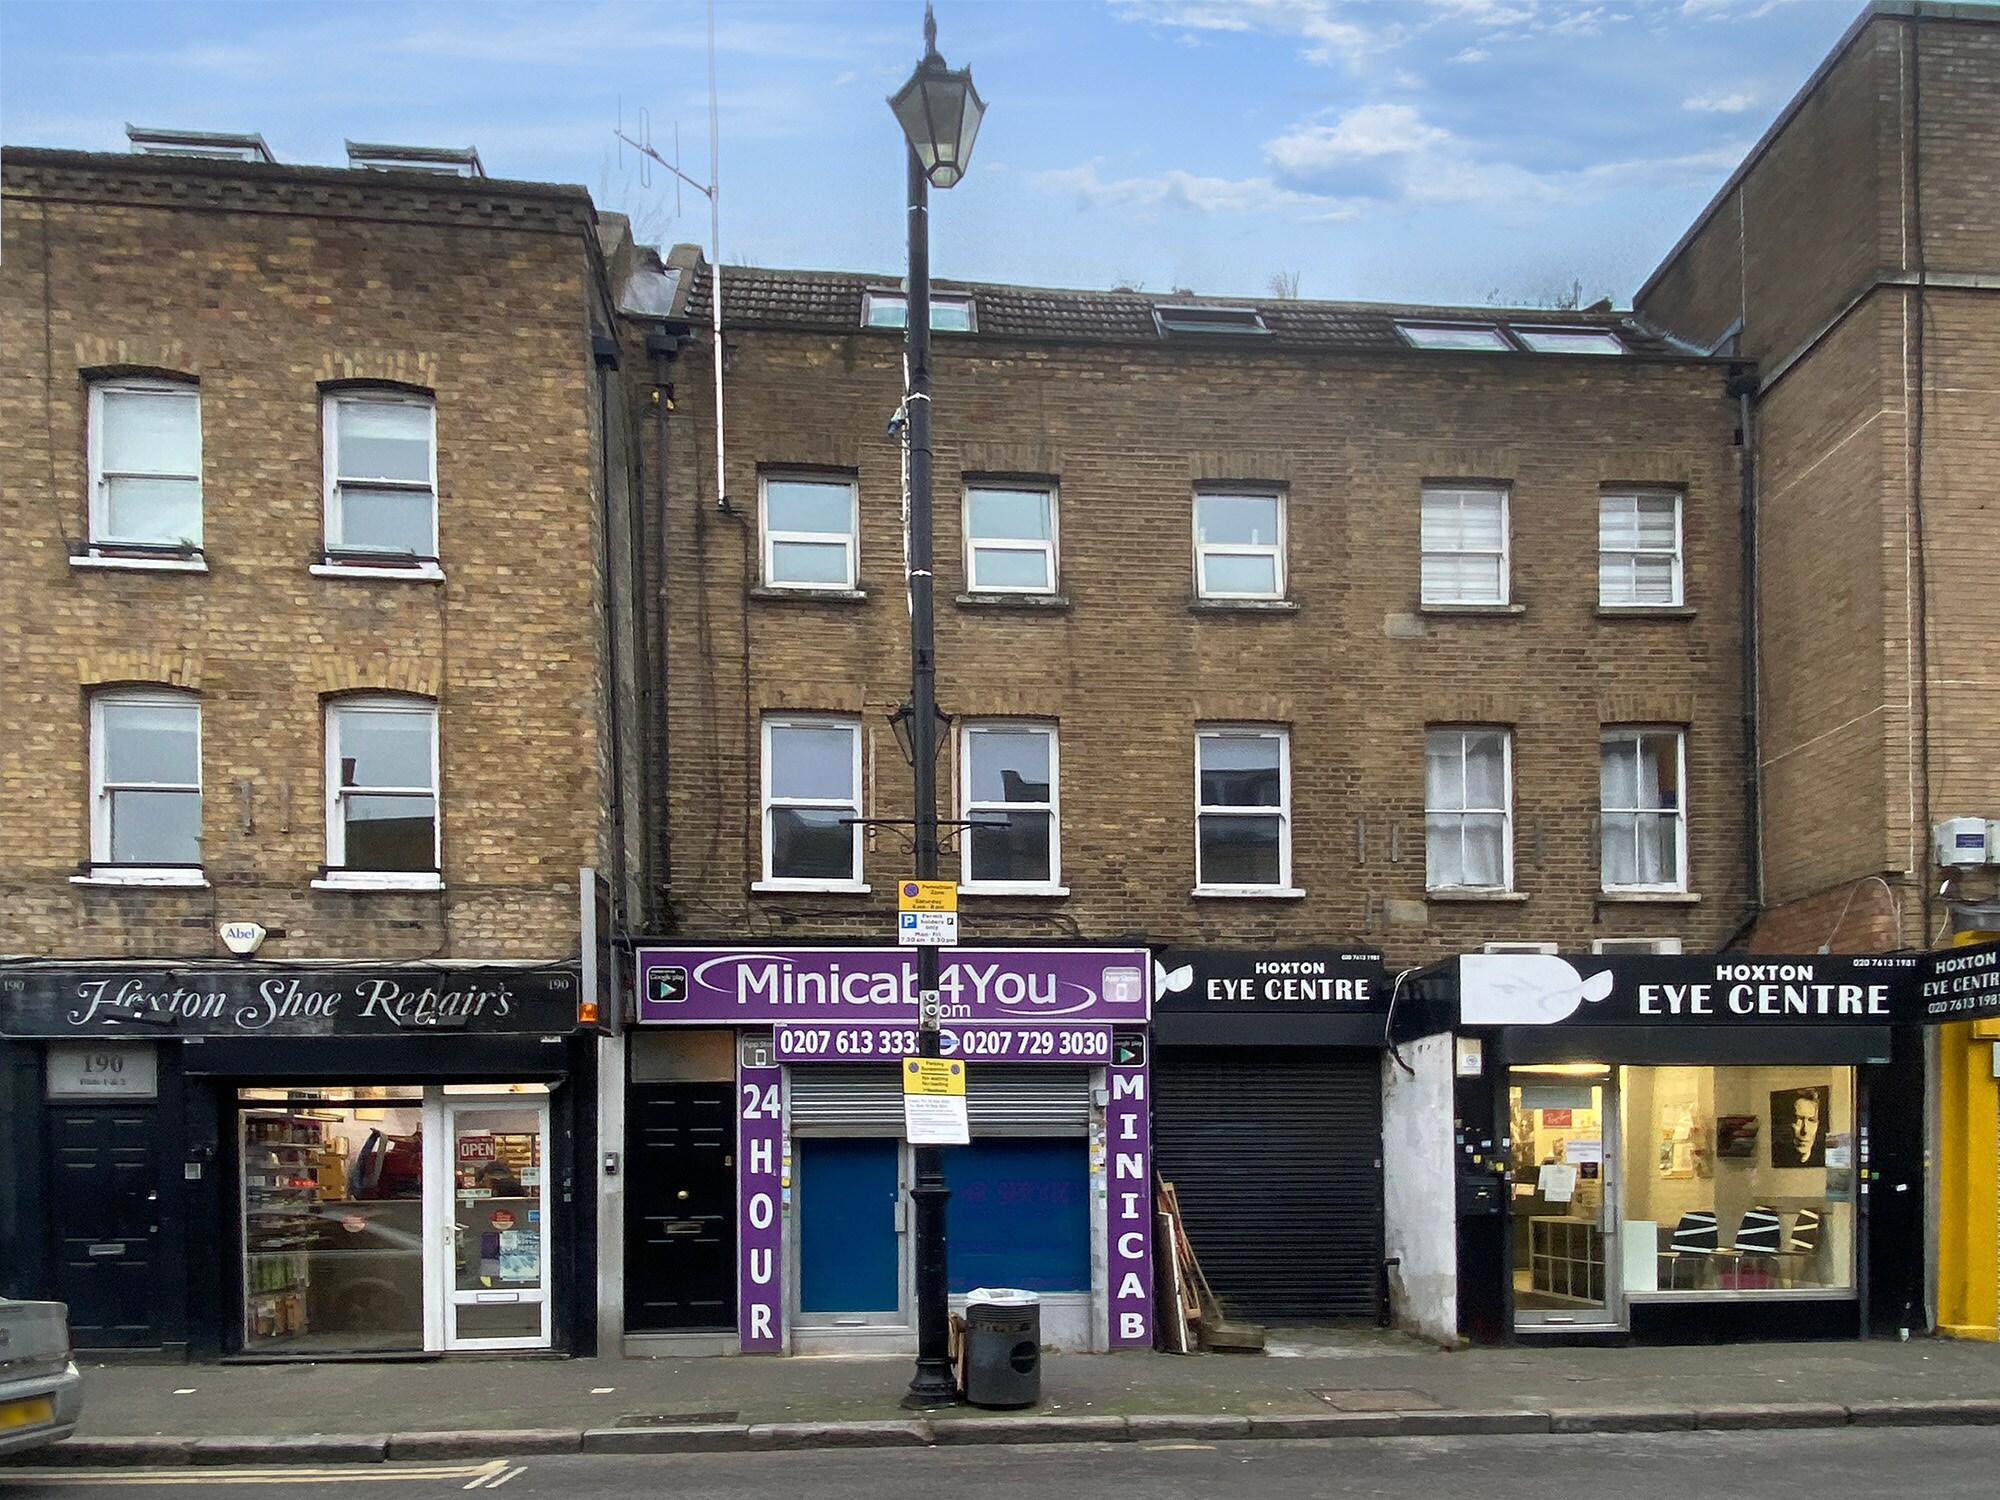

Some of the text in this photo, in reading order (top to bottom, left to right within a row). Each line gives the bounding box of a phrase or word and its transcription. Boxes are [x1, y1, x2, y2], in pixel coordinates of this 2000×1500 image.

[904, 915, 914, 927] P
[225, 927, 255, 939] Abel
[1255, 962, 1325, 975] HOXTON
[1853, 959, 1916, 967] 020 7613 1981
[1935, 951, 1997, 974] HOXTON
[1716, 965, 1814, 981] HOXTON
[4, 981, 25, 992] 190
[549, 979, 569, 990] 190
[1207, 978, 1371, 1001] EYE CENTRE
[1923, 971, 2000, 997] EYE CENTR
[235, 979, 342, 1030] Shoe
[1639, 984, 1890, 1014] EYE CENTRE
[1928, 1000, 1948, 1014] 020
[1949, 996, 1975, 1011] 7613
[780, 1030, 920, 1054] 0207 613 333
[962, 1031, 1108, 1055] 0207 729 3030
[84, 1054, 125, 1073] 190
[461, 1143, 494, 1157] OPEN
[742, 1083, 781, 1340] 24 HOUR
[1112, 1074, 1146, 1340] MINICAB
